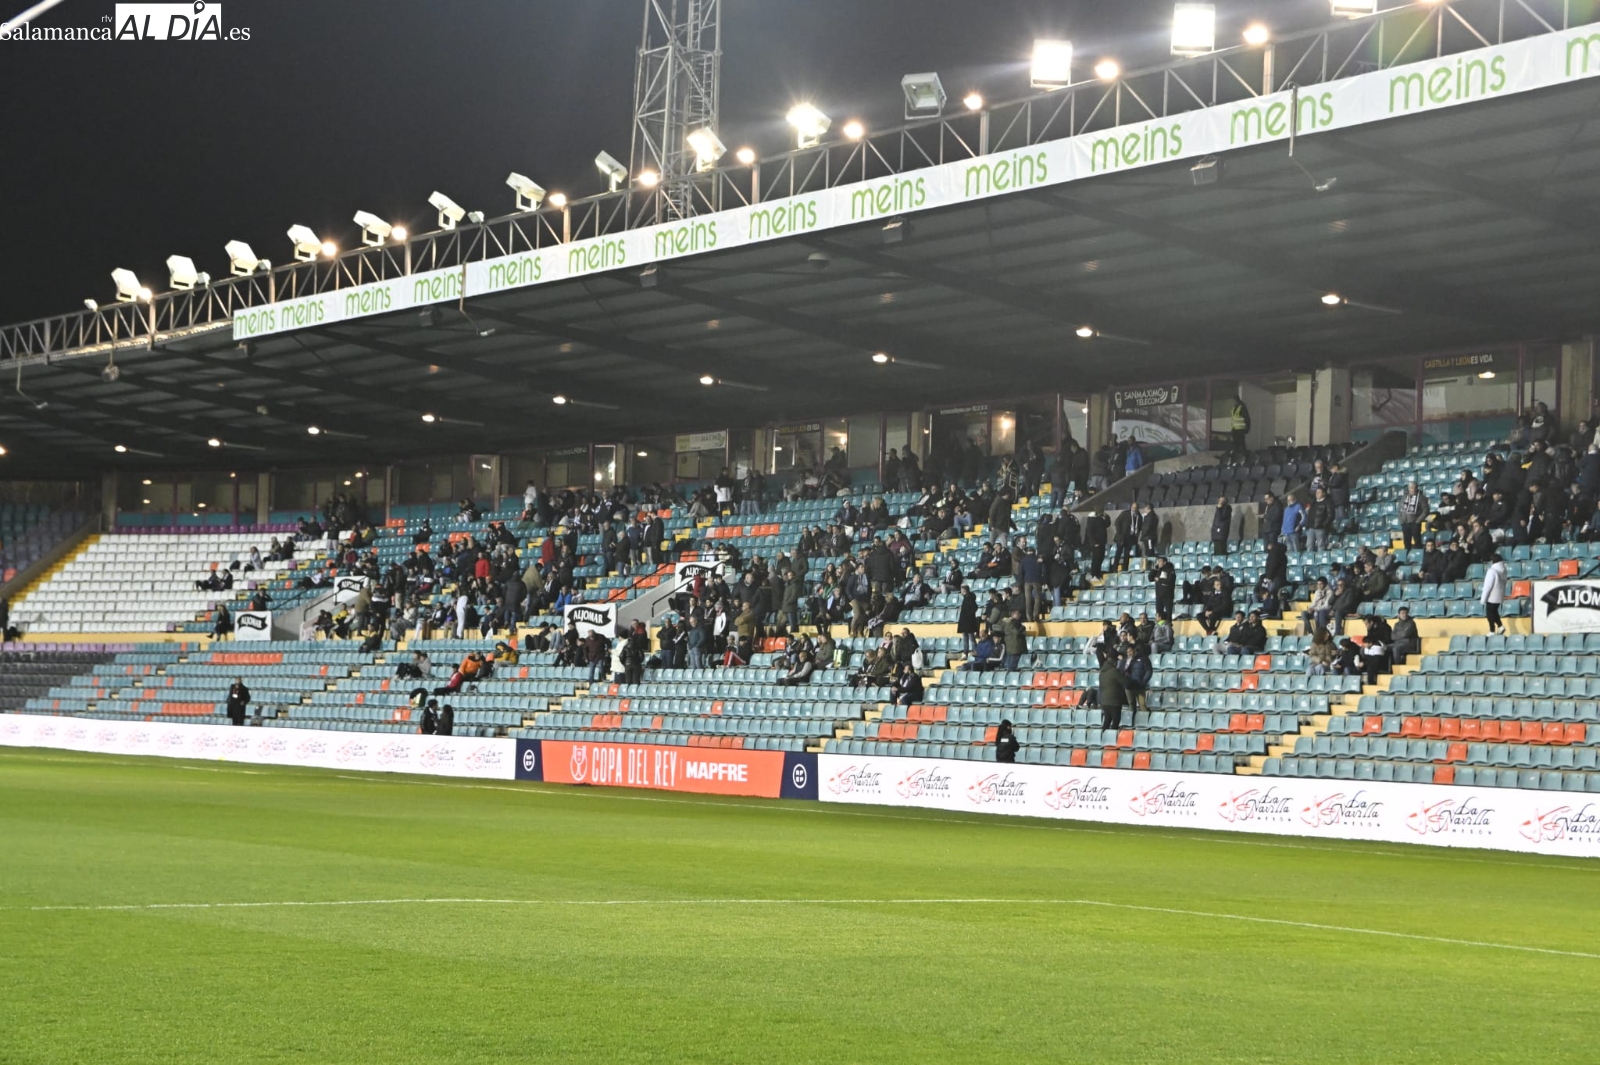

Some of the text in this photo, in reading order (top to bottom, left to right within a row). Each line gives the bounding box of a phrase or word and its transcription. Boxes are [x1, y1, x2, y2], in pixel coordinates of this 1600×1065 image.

[234, 309, 275, 336] meins
[281, 299, 324, 326] meins
[345, 286, 391, 316] meins
[489, 256, 542, 289] meins
[568, 237, 626, 274] meins
[654, 220, 718, 257] meins
[748, 199, 818, 239] meins
[851, 176, 926, 220] meins
[965, 151, 1048, 197] meins
[1091, 123, 1183, 172] meins
[1230, 92, 1334, 145] mens
[1389, 55, 1506, 113] meins
[1480, 354, 1493, 364] VIDA
[1136, 398, 1160, 406] TELECOM
[1557, 589, 1600, 607] ALJOM
[573, 609, 603, 624] ALJOMAR
[591, 747, 748, 787] COPA DEL REY MAPFRE
[1453, 796, 1478, 815] La
[1570, 803, 1596, 823] La
[1431, 808, 1495, 833] Navilla
